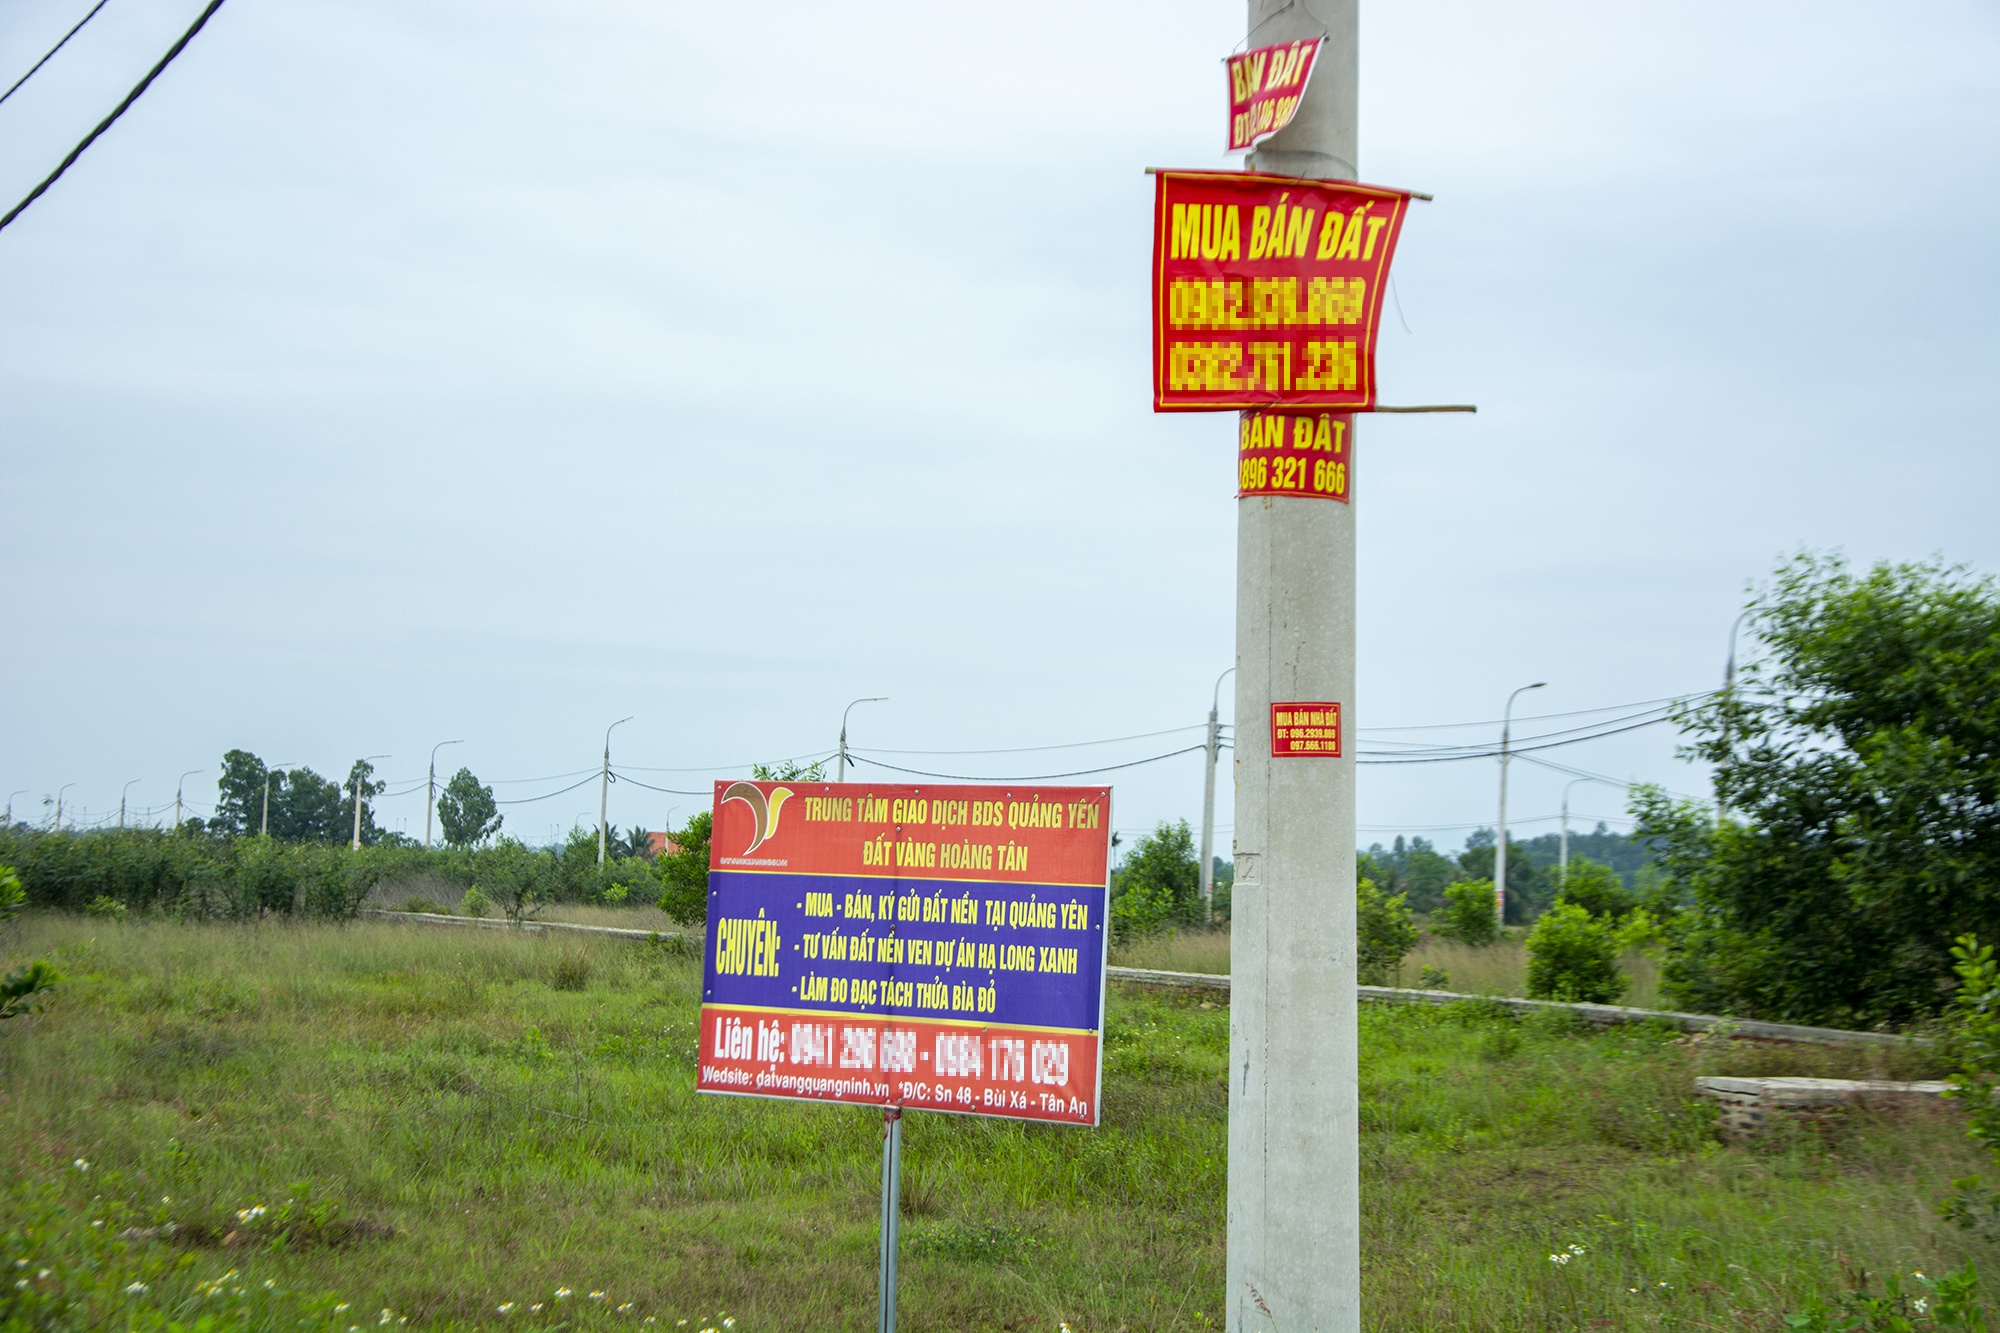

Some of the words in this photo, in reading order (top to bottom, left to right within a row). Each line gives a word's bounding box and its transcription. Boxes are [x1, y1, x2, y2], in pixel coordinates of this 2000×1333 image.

[1170, 203, 1241, 261] MUA
[1247, 192, 1316, 260] BÁN
[1316, 200, 1387, 261] ĐẤT
[1241, 412, 1285, 450] BÁN
[1240, 456, 1267, 489] 896
[1271, 456, 1307, 489] 321
[1313, 459, 1345, 494] 666
[1276, 711, 1293, 726] MUA
[1294, 708, 1309, 726] BÁN
[1310, 708, 1325, 726] NHÀ
[1325, 707, 1337, 726] ĐẤT
[805, 797, 852, 822] TRUNG
[857, 793, 889, 823] TÂM
[893, 798, 928, 824] GIAO
[932, 799, 968, 831] DỊCH
[972, 801, 1004, 827] BDS
[1008, 794, 1063, 830] QUẢNG
[1068, 798, 1099, 829] YÊN
[863, 832, 892, 866] ĐẤT
[896, 836, 936, 867] VÀNG
[940, 838, 993, 870] HOÀNG
[997, 840, 1028, 871] TÂN
[805, 892, 833, 917] MUA
[844, 889, 875, 922] BÁN,
[878, 890, 895, 920] KÝ
[898, 888, 920, 921] GỬI
[923, 889, 948, 922] ĐẤT
[950, 890, 978, 924] NỀN
[985, 900, 1006, 931] TẠI
[1009, 893, 1056, 930] QUẢNG
[1060, 898, 1088, 930] YÊN
[715, 908, 781, 977] CHUYÊN:
[803, 931, 821, 959] TƯ
[822, 926, 847, 960] VẤN
[849, 928, 875, 962] ĐẤT
[877, 930, 904, 964] NỀN
[908, 939, 932, 965] VEN
[935, 939, 955, 972] DỰ
[956, 937, 975, 968] ÁN
[978, 943, 996, 975] HẠ
[1000, 944, 1035, 972] LONG
[1039, 947, 1078, 974] XANH
[800, 971, 828, 1001] LÀM
[830, 977, 848, 1003] ĐO
[850, 978, 877, 1010] ĐẠC
[880, 976, 913, 1008] TÁCH
[916, 975, 949, 1010] THỬA
[952, 980, 975, 1011] BÌA
[977, 979, 996, 1013] ĐỎ
[714, 1016, 753, 1060] Liên
[756, 1019, 785, 1071] hệ:
[935, 1083, 952, 1102] Sn
[956, 1086, 971, 1104] 48
[983, 1088, 1006, 1107] Bùi
[1009, 1090, 1027, 1109] Xá
[1039, 1093, 1065, 1113] Tân
[1068, 1096, 1088, 1115] An
